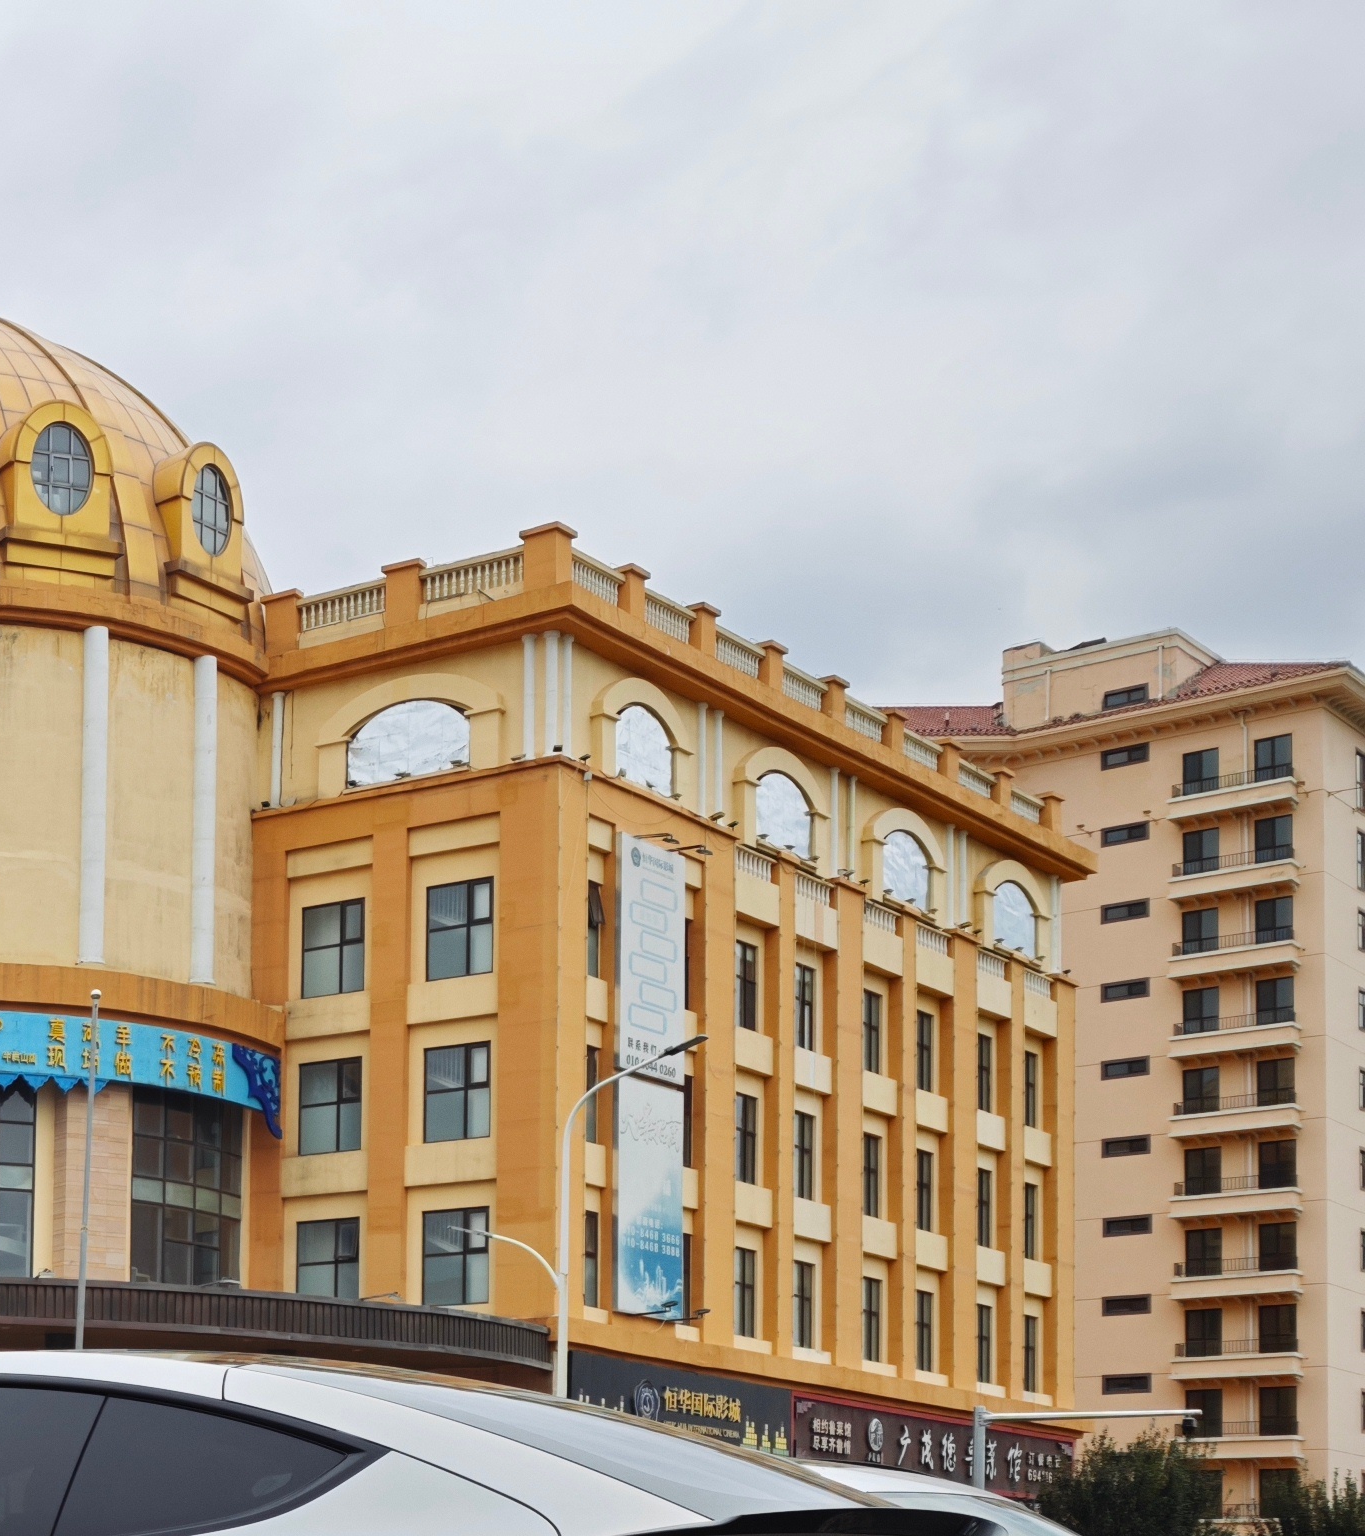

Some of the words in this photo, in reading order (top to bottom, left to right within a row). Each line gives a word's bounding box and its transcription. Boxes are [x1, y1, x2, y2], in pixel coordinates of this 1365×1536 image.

[659, 1064, 676, 1078] 0260
[664, 1386, 742, 1424] 恒华国际影城
[723, 1428, 741, 1439] CINEMA
[812, 1417, 852, 1438] 相约鲁菜馆
[812, 1435, 851, 1455] 尽享齐鲁情
